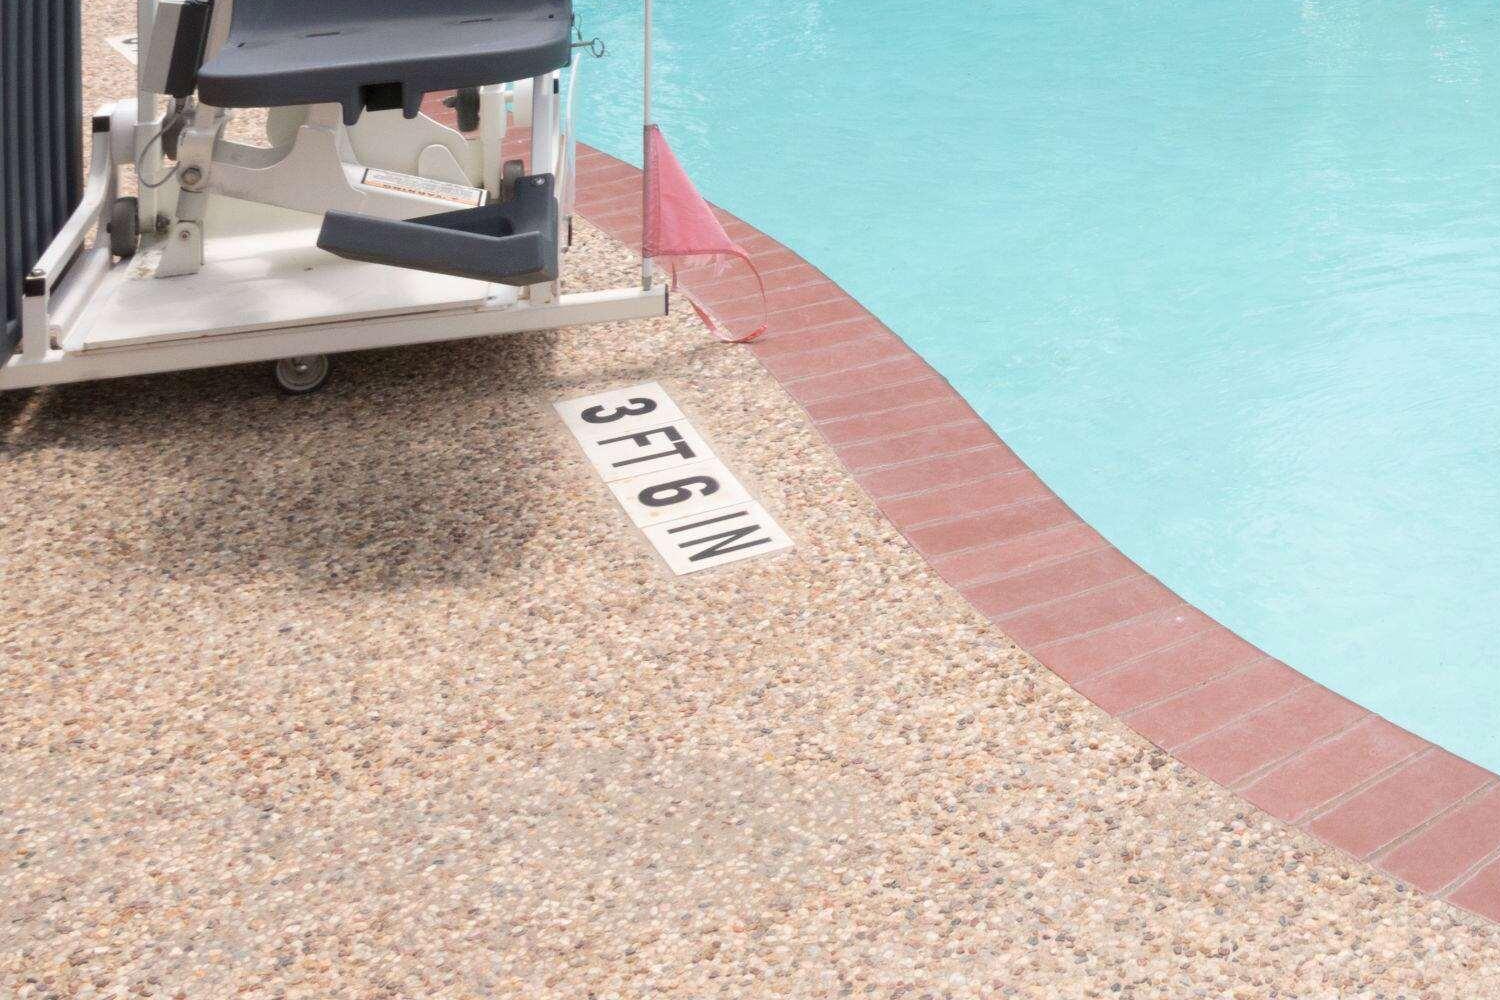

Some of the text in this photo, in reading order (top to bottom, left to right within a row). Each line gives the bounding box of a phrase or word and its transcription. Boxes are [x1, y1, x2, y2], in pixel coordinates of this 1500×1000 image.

[581, 397, 773, 562] 3 FT 6 IN
